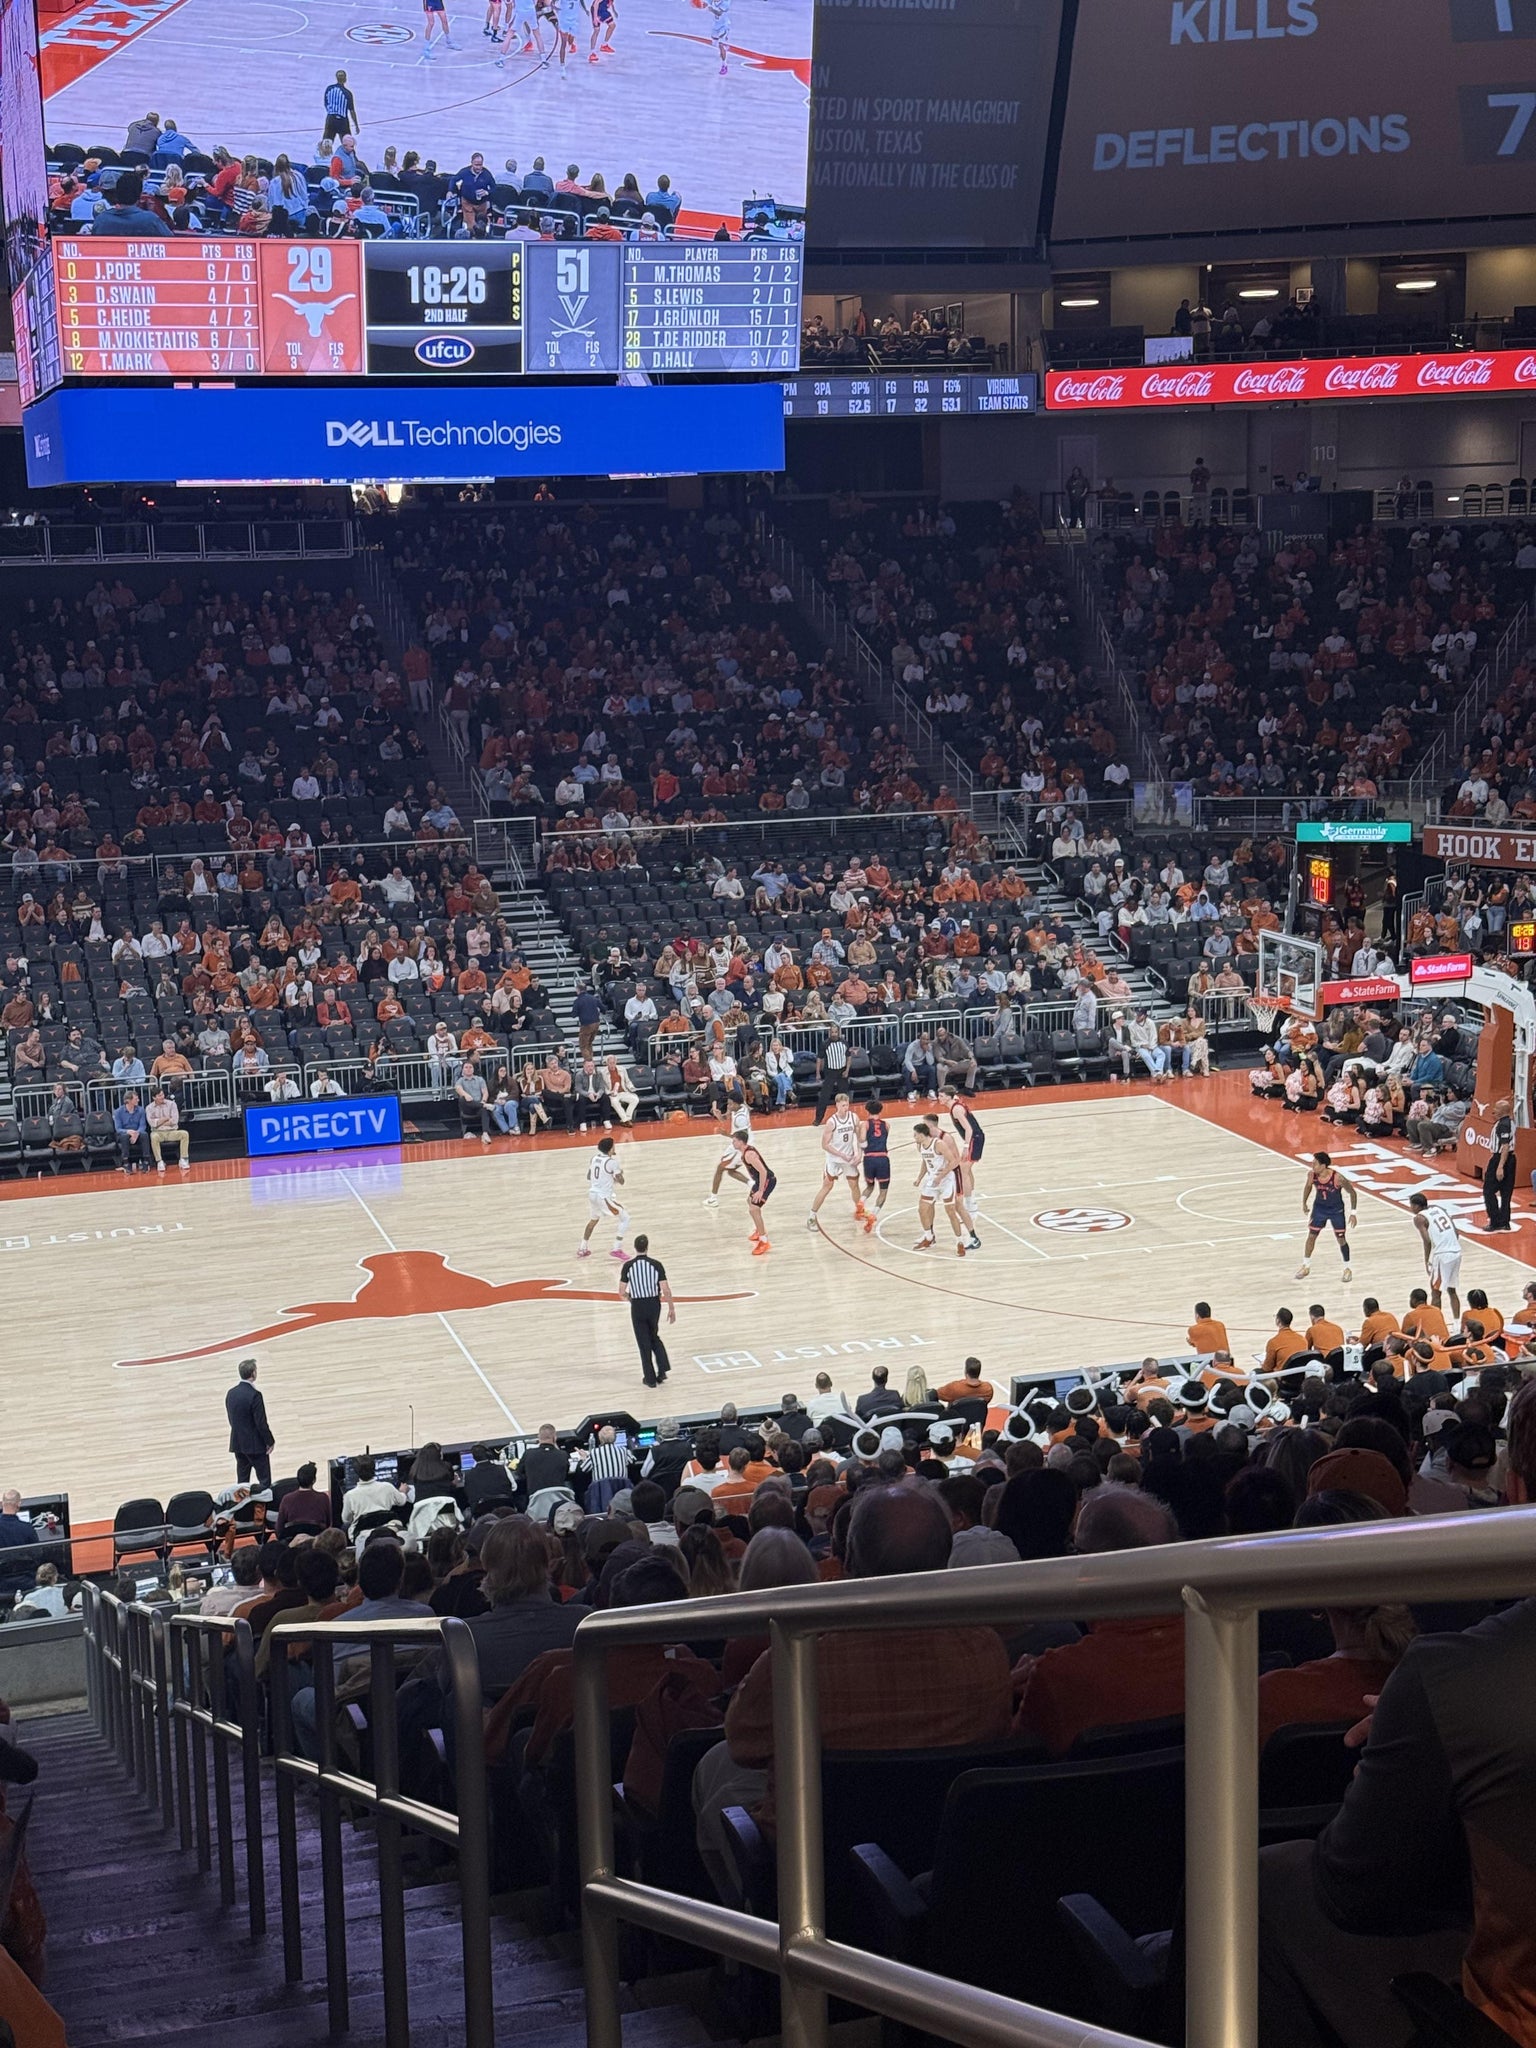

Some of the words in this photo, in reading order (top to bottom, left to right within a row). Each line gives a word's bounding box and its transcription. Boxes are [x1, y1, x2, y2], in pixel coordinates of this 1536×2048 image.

[1170, 0, 1319, 45] KILLS
[851, 98, 868, 121] IN
[873, 98, 923, 122] SPORT
[926, 99, 1021, 124] MANAGEMENT
[1487, 92, 1536, 156] 7
[876, 130, 923, 154] TEXAS
[1092, 114, 1411, 171] DEFLECTIONS
[910, 163, 926, 187] IN
[932, 163, 960, 188] THE
[963, 164, 998, 189] CLASS
[1000, 165, 1018, 189] OF
[63, 243, 82, 257] NO.
[128, 244, 166, 258] PLAYER
[202, 245, 221, 258] PTS
[235, 245, 252, 259] FLS
[628, 248, 645, 261] NO.
[685, 248, 719, 261] PLAYER
[750, 248, 768, 261] PTS
[779, 248, 796, 261] FLS
[67, 262, 76, 280] 0
[95, 262, 141, 281] J.POPE
[207, 263, 216, 281] 6
[242, 264, 250, 281] 0
[287, 246, 332, 293] 29
[556, 249, 590, 293] 51
[631, 266, 637, 282] 1
[654, 265, 721, 282] M.THOMAS
[753, 265, 761, 282] 2
[784, 265, 792, 282] 2
[407, 266, 486, 304] 18:26
[69, 286, 77, 304] 3
[95, 286, 156, 304] D.SWAIN
[208, 287, 216, 304] 4
[244, 288, 250, 304] 1
[630, 288, 638, 305] 5
[654, 288, 703, 305] S.LEWIS
[753, 288, 760, 304] 2
[783, 288, 791, 304] 0
[70, 309, 78, 326] 5
[97, 309, 151, 326] C.HEIDE
[209, 310, 217, 327] 4
[244, 310, 252, 327] 2
[424, 309, 444, 323] 2ND
[446, 309, 468, 323] HALF
[628, 310, 639, 326] 17
[653, 307, 720, 326] J.GRÜNLOH
[749, 309, 762, 325] 15
[784, 309, 789, 325] 1
[72, 331, 80, 348] 8
[98, 331, 199, 349] M.VOKIETAITIS
[210, 332, 219, 348] 6
[246, 332, 251, 348] 1
[626, 331, 641, 347] 28
[653, 330, 682, 347] T.DE
[683, 330, 726, 347] RIDDER
[749, 330, 761, 346] 10
[782, 330, 789, 346] 2
[286, 342, 302, 355] TOL
[329, 342, 344, 355] FLS
[425, 341, 465, 359] ufcu
[545, 341, 561, 355] TOL
[585, 341, 600, 354] FLS
[70, 353, 84, 370] 12
[100, 353, 153, 370] T.MARK
[211, 354, 220, 370] 3
[246, 354, 254, 370] 0
[333, 356, 339, 369] 2
[549, 355, 556, 367] 3
[589, 354, 596, 367] 2
[625, 352, 641, 368] 30
[653, 352, 694, 368] D.HALL
[751, 351, 758, 366] 3
[781, 350, 788, 366] 0
[780, 383, 797, 396] PM
[814, 382, 831, 395] 3PA
[851, 381, 870, 395] 3P%
[885, 381, 897, 394] FG
[913, 380, 929, 393] FGA
[943, 380, 961, 393] FG%
[987, 379, 1019, 394] VIRGINIA
[817, 400, 828, 414] 19
[849, 399, 871, 414] 52.6
[887, 399, 896, 412] 17
[915, 398, 927, 412] 32
[942, 398, 960, 411] 53.1
[978, 397, 1001, 410] TEAM
[1003, 396, 1028, 409] STATS
[326, 420, 404, 447] DELL
[401, 420, 561, 451] Technologies
[1313, 446, 1336, 461] 110
[1340, 825, 1386, 835] Germania
[1437, 834, 1500, 859] HOOK
[1510, 838, 1536, 862] 'E
[261, 1108, 387, 1143] DIRECTV
[1434, 1216, 1451, 1232] 12
[41, 1222, 193, 1245] TRUIST
[771, 1334, 937, 1362] TRUIST
